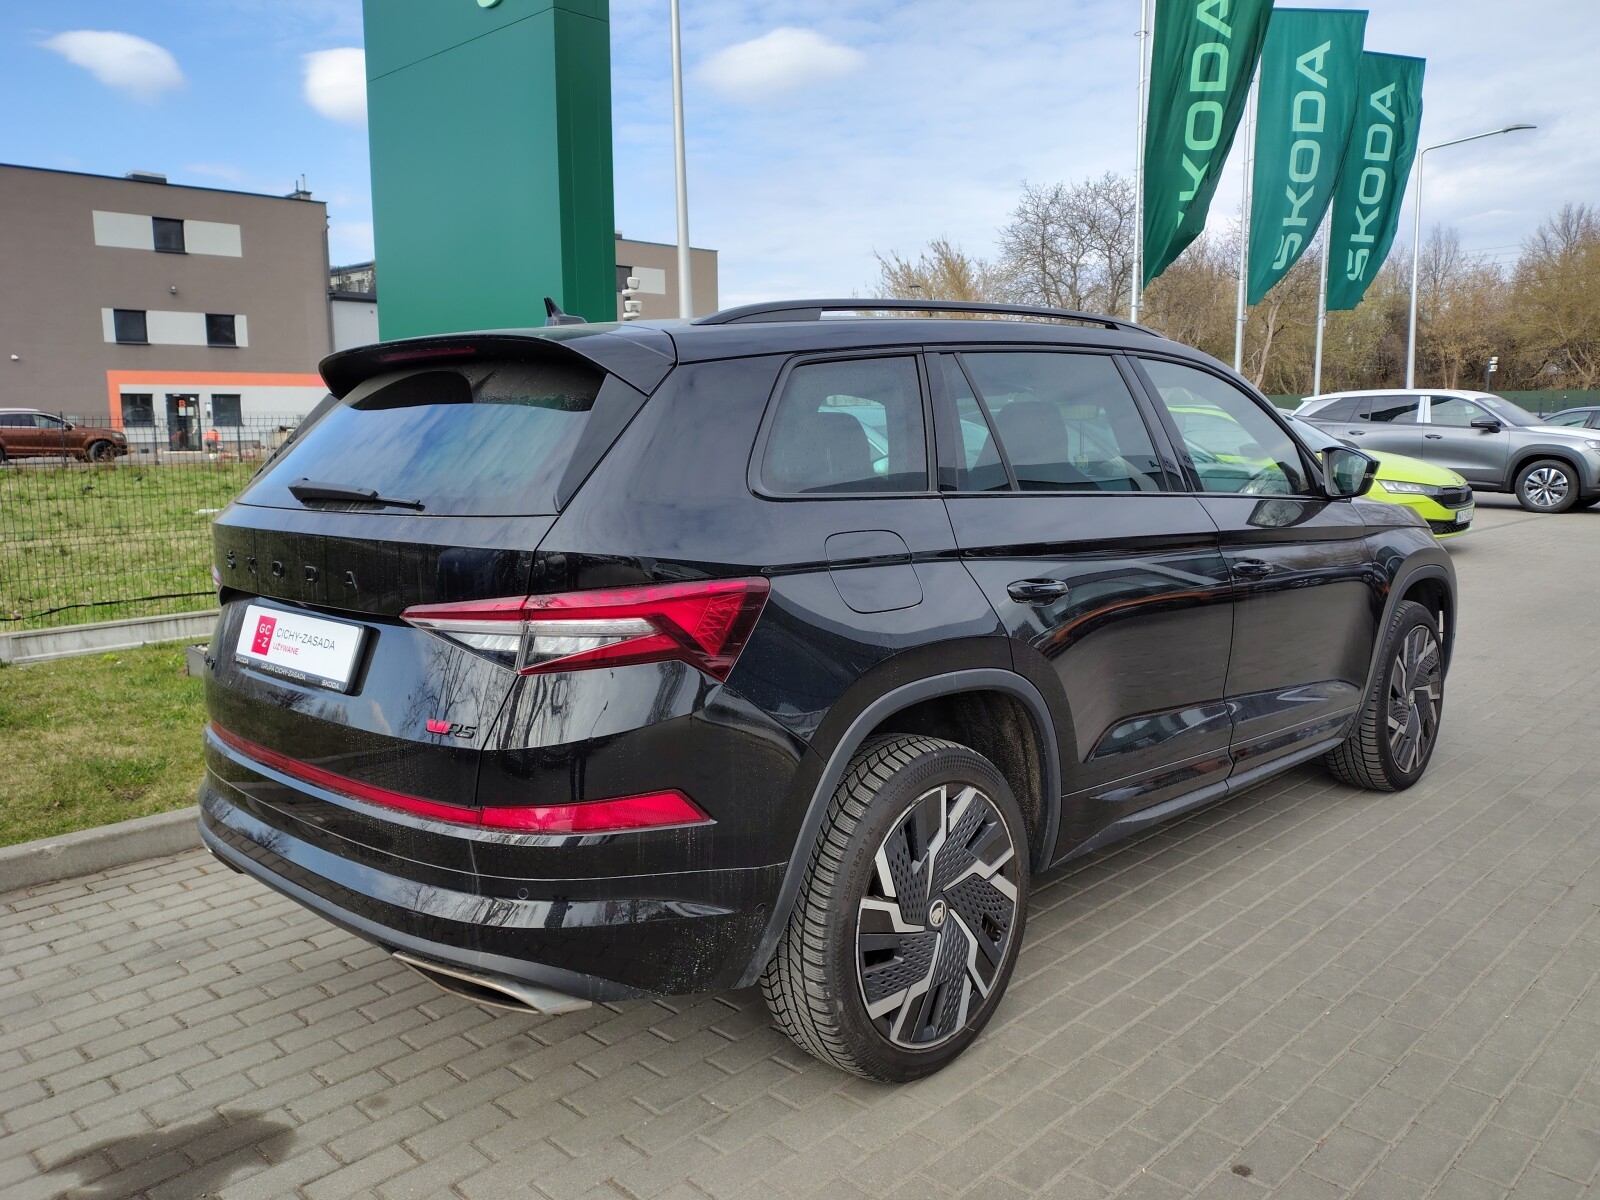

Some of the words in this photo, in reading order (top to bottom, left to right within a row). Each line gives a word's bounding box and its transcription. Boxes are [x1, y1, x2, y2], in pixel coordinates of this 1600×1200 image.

[1177, 0, 1231, 229] KODA
[259, 623, 272, 635] GC
[276, 628, 335, 650] CICHY-ZASADA
[275, 667, 306, 681] CICHY-ZASADA
[843, 870, 857, 902] 235/45
